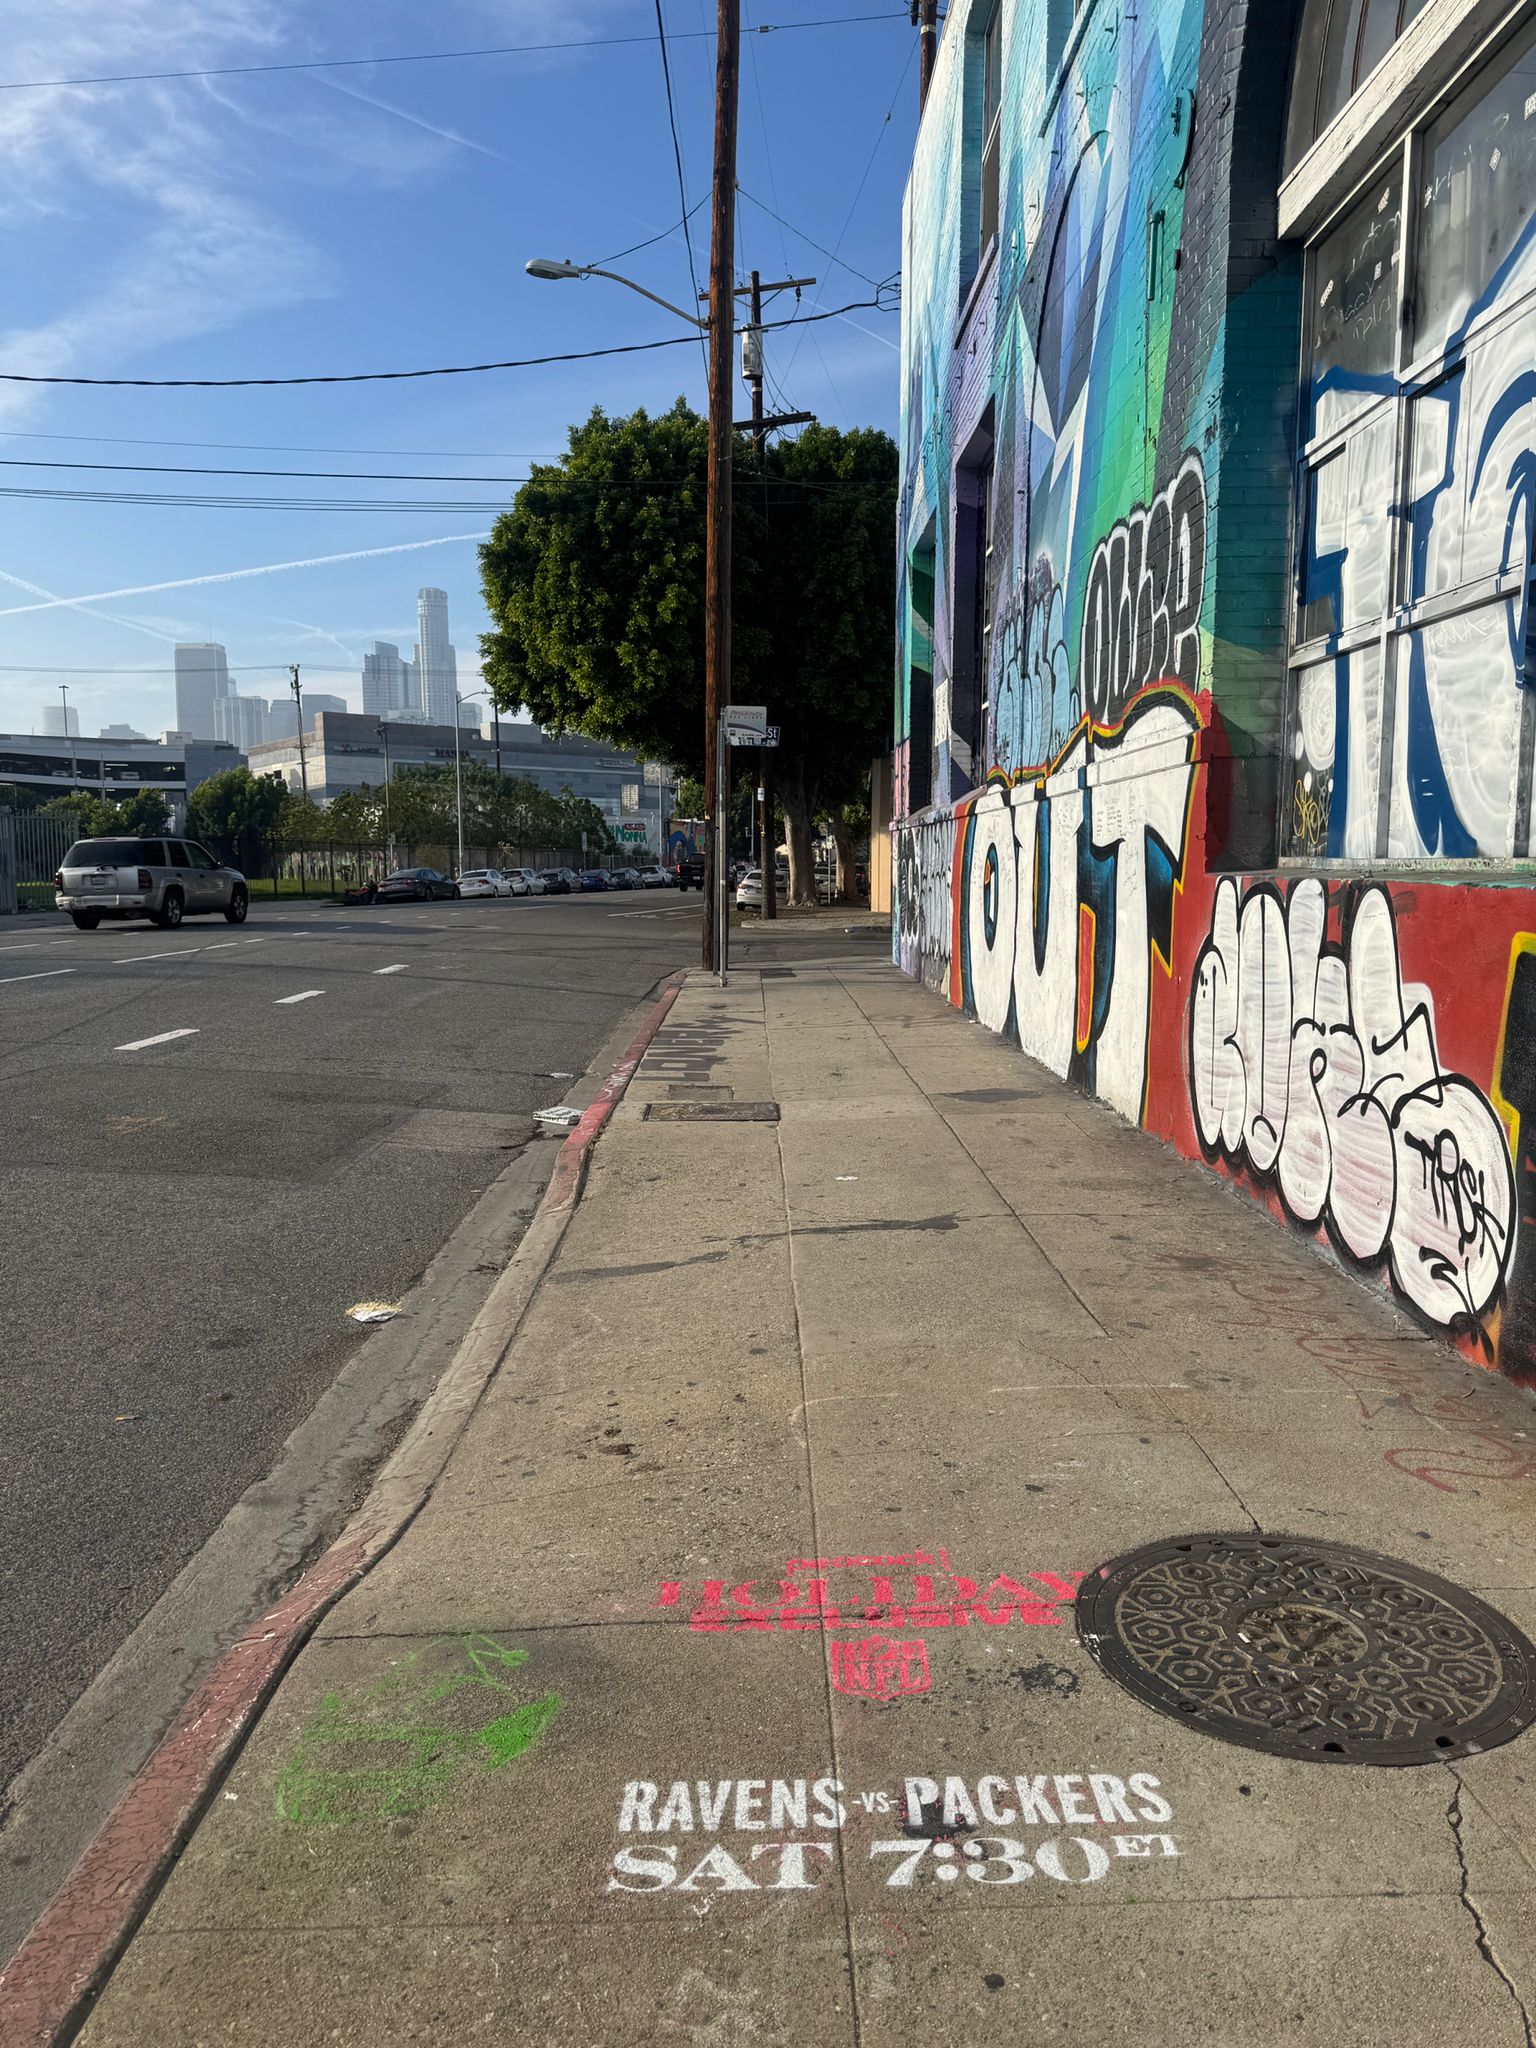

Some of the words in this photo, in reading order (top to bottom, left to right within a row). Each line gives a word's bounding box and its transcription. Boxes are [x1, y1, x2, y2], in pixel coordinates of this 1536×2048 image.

[767, 727, 777, 739] St
[786, 1549, 936, 1577] peacock
[652, 1571, 1089, 1608] HOLIDAY
[689, 1603, 1065, 1632] EXCLUSIVE
[843, 1661, 922, 1693] NFL
[617, 1777, 847, 1833] RAVENS
[904, 1772, 1174, 1827] PACKERS
[606, 1842, 834, 1893] SAT
[869, 1837, 1110, 1887] 7:30
